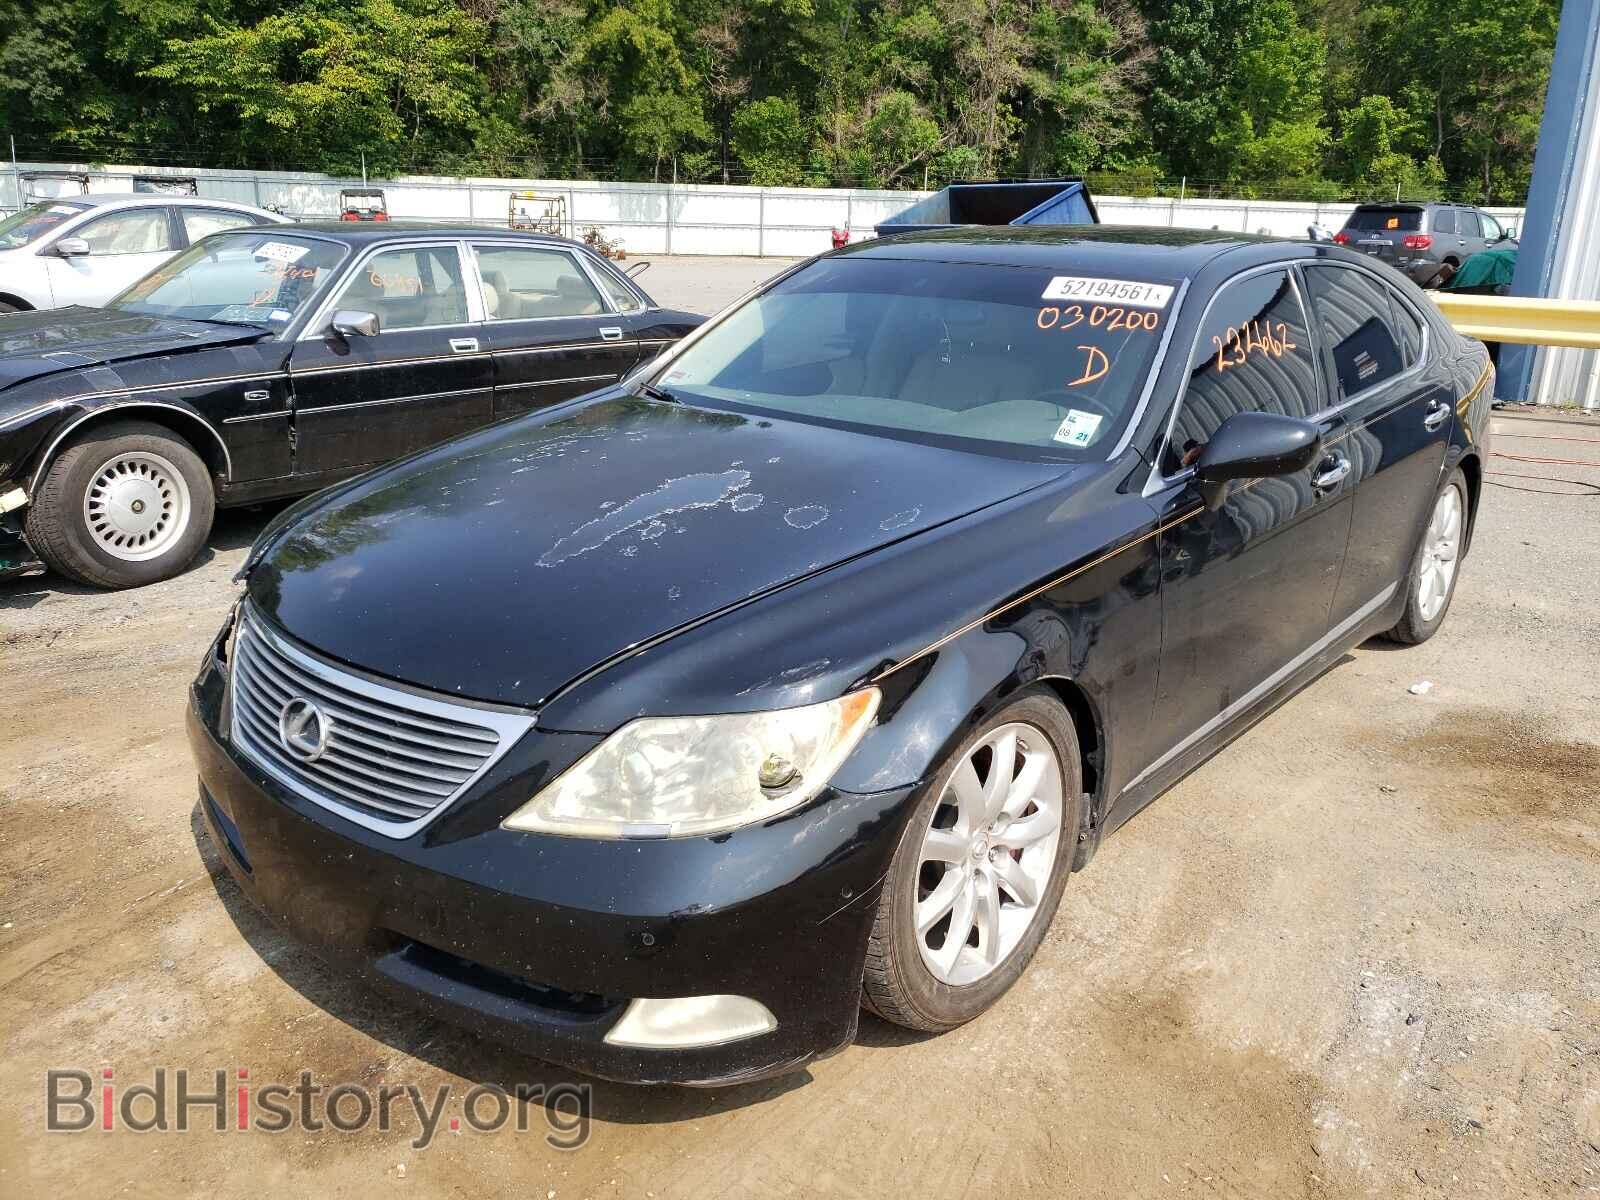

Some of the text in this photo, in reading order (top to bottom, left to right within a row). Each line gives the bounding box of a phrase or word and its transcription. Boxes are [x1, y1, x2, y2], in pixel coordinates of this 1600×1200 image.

[1060, 280, 1153, 301] 52194561
[1037, 305, 1159, 331] 030200
[1067, 345, 1110, 387] D
